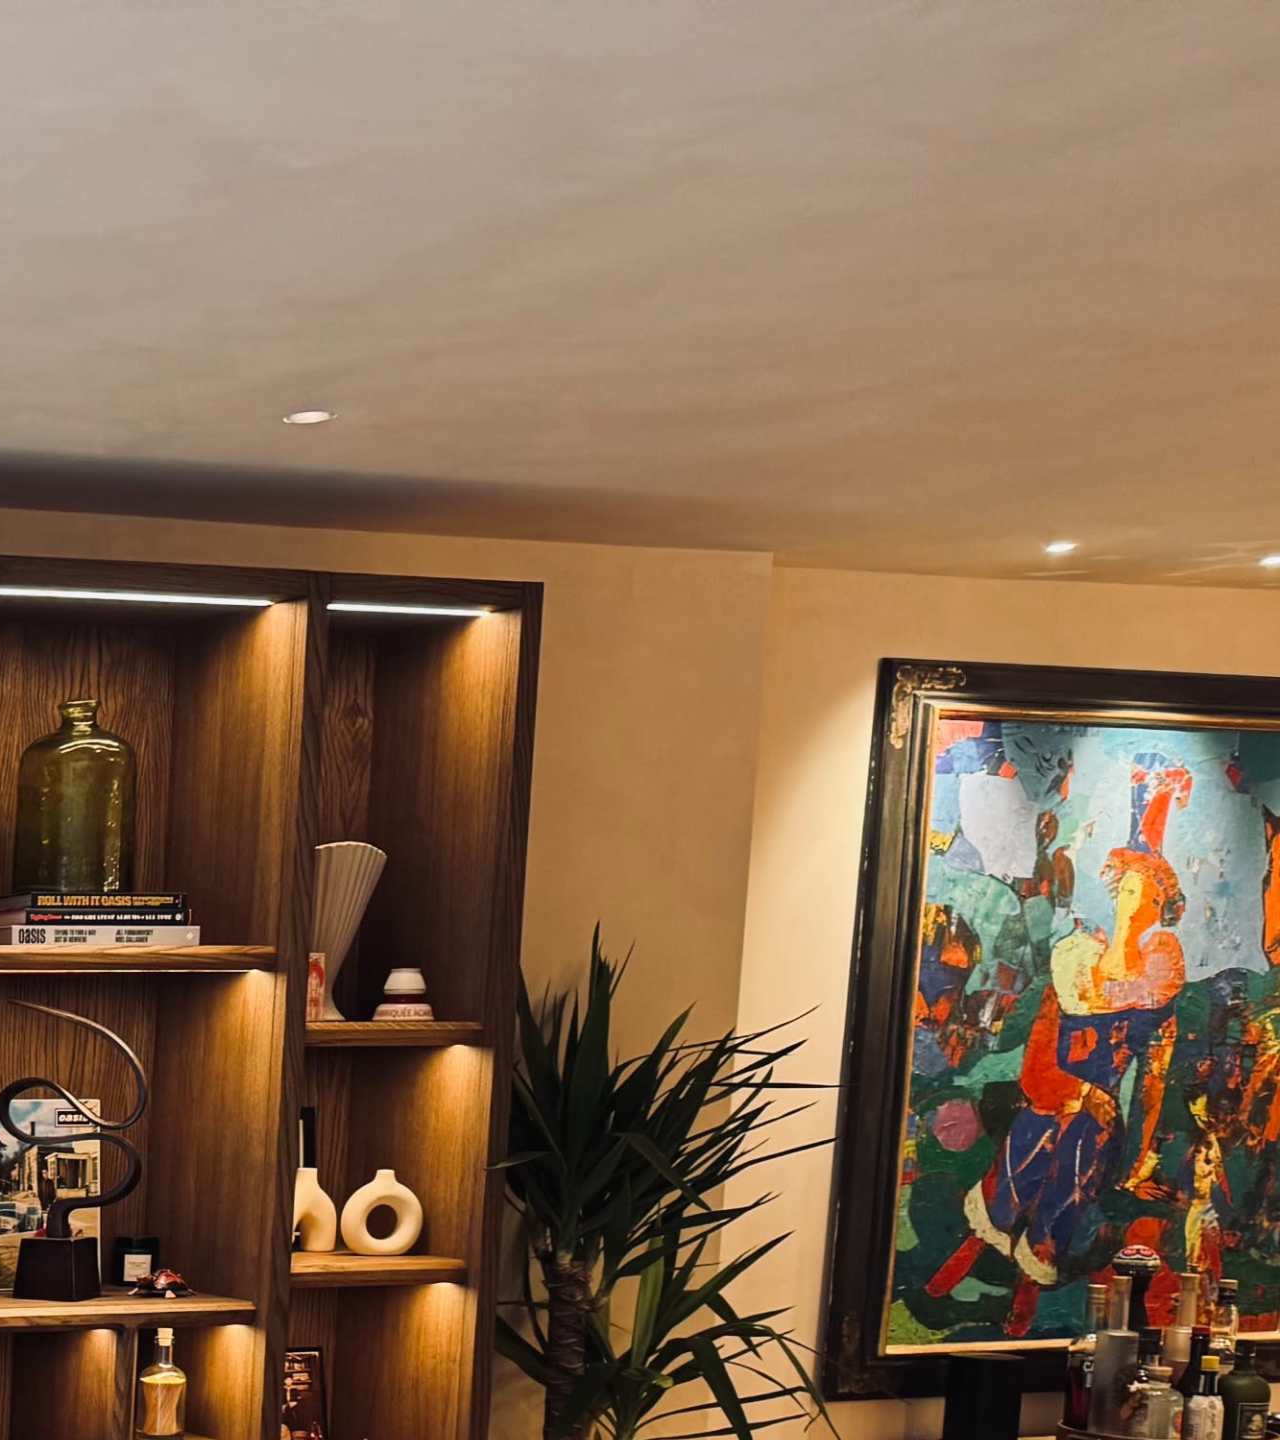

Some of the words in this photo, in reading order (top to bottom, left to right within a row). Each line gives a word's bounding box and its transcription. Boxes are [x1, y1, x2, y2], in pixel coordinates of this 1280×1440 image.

[37, 896, 62, 905] ROLL
[64, 896, 90, 905] WITH
[91, 896, 100, 905] IT
[101, 896, 131, 905] OASIS
[18, 928, 46, 944] oasis
